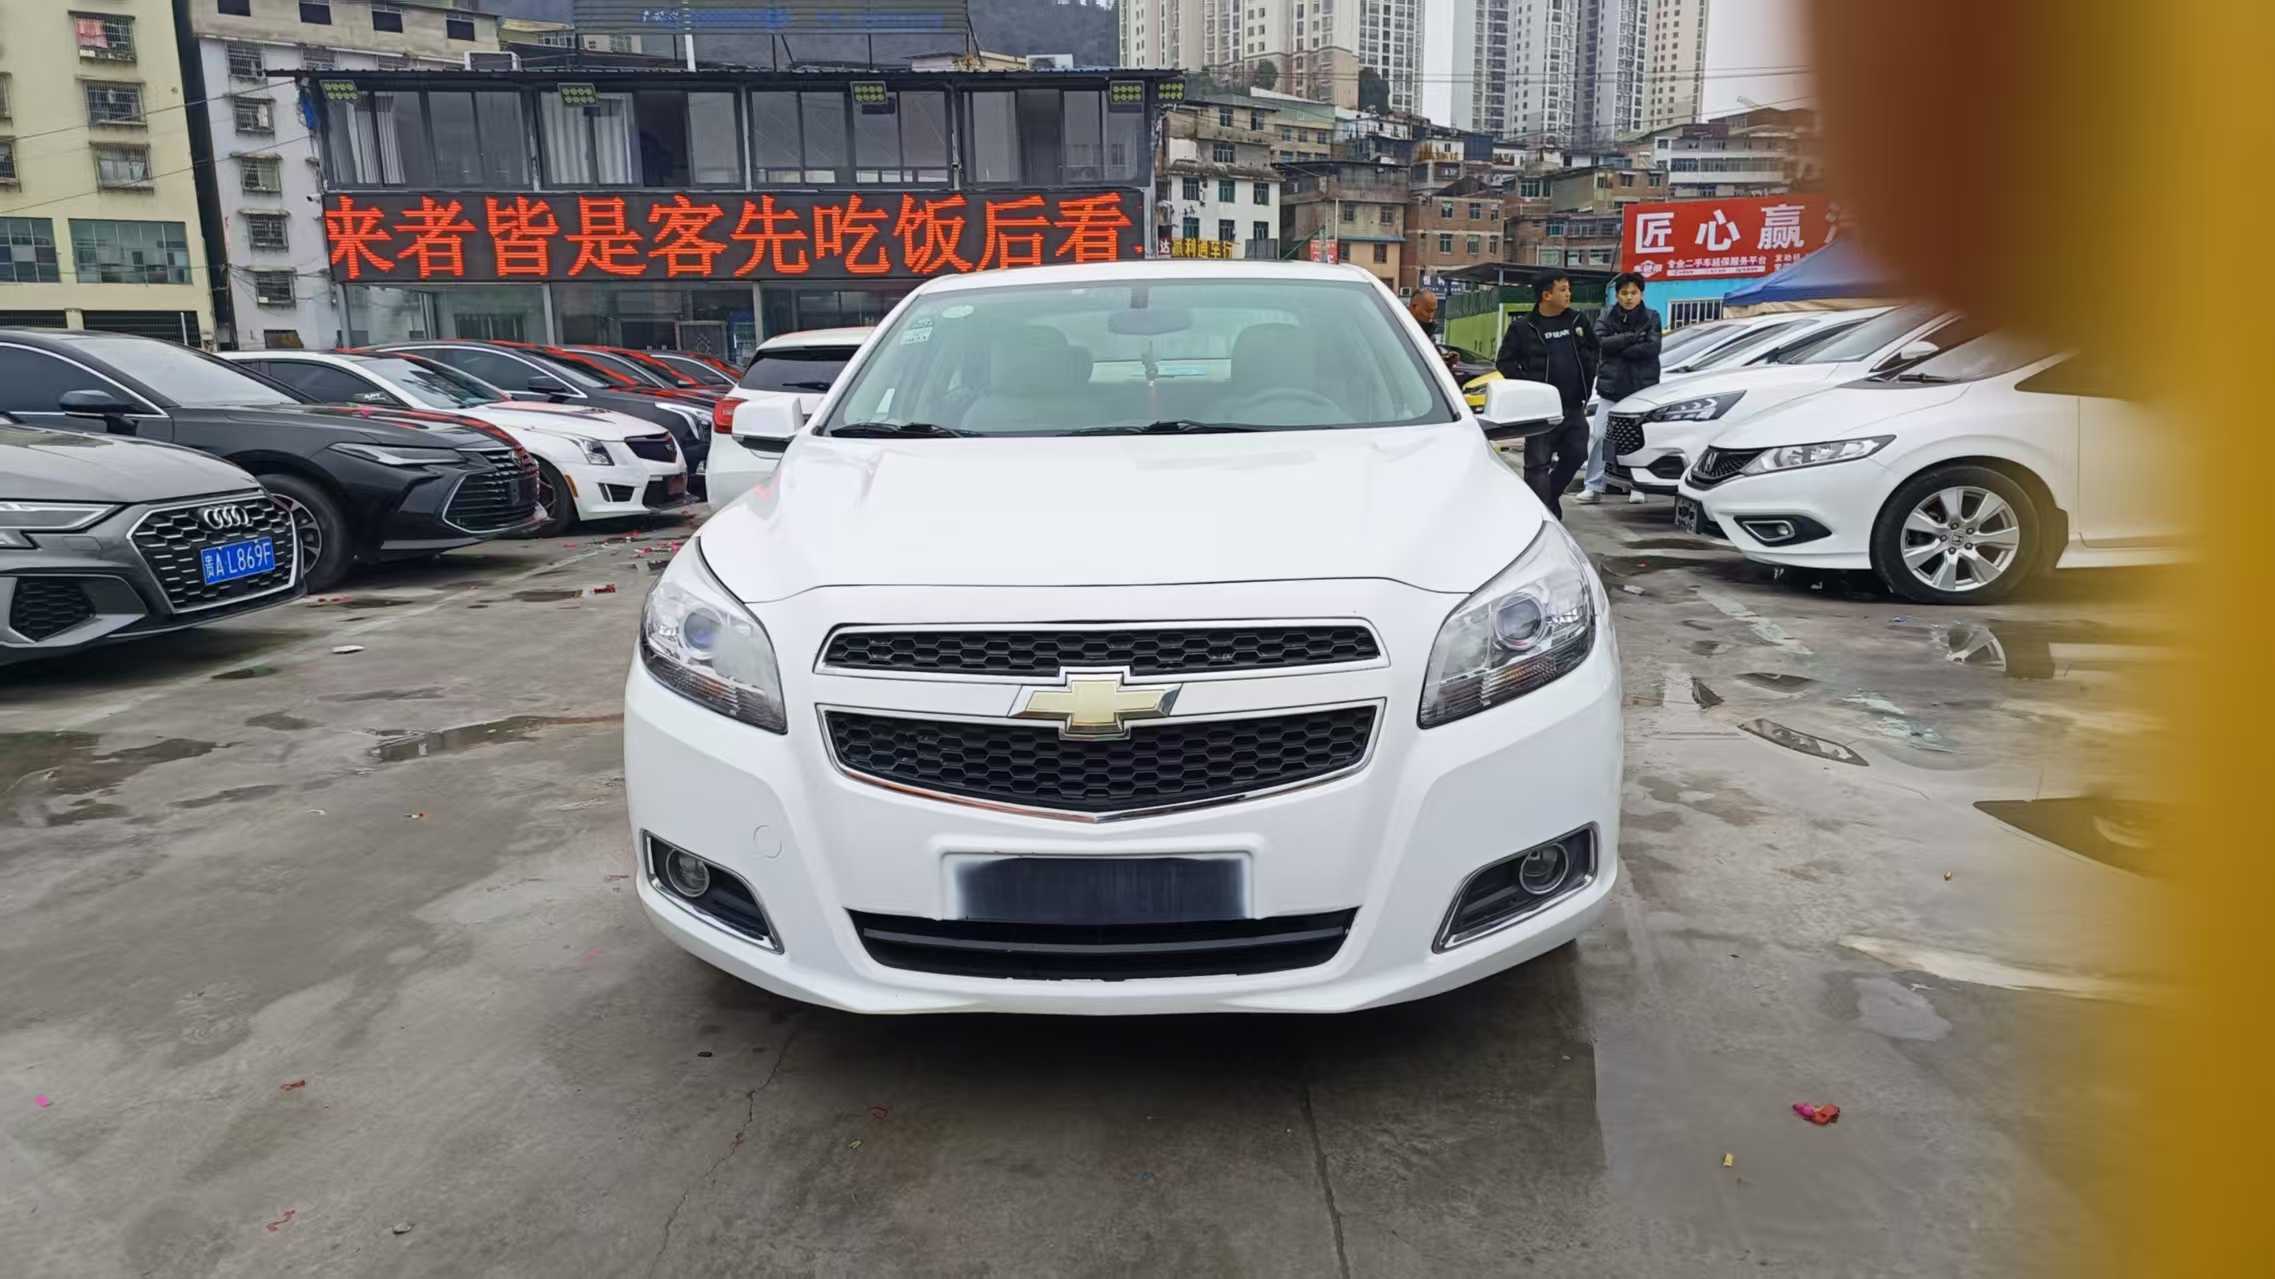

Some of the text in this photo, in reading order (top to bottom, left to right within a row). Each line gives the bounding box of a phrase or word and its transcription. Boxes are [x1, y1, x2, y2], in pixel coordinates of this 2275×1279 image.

[325, 192, 1132, 279] 来者皆是客先吃饭后看
